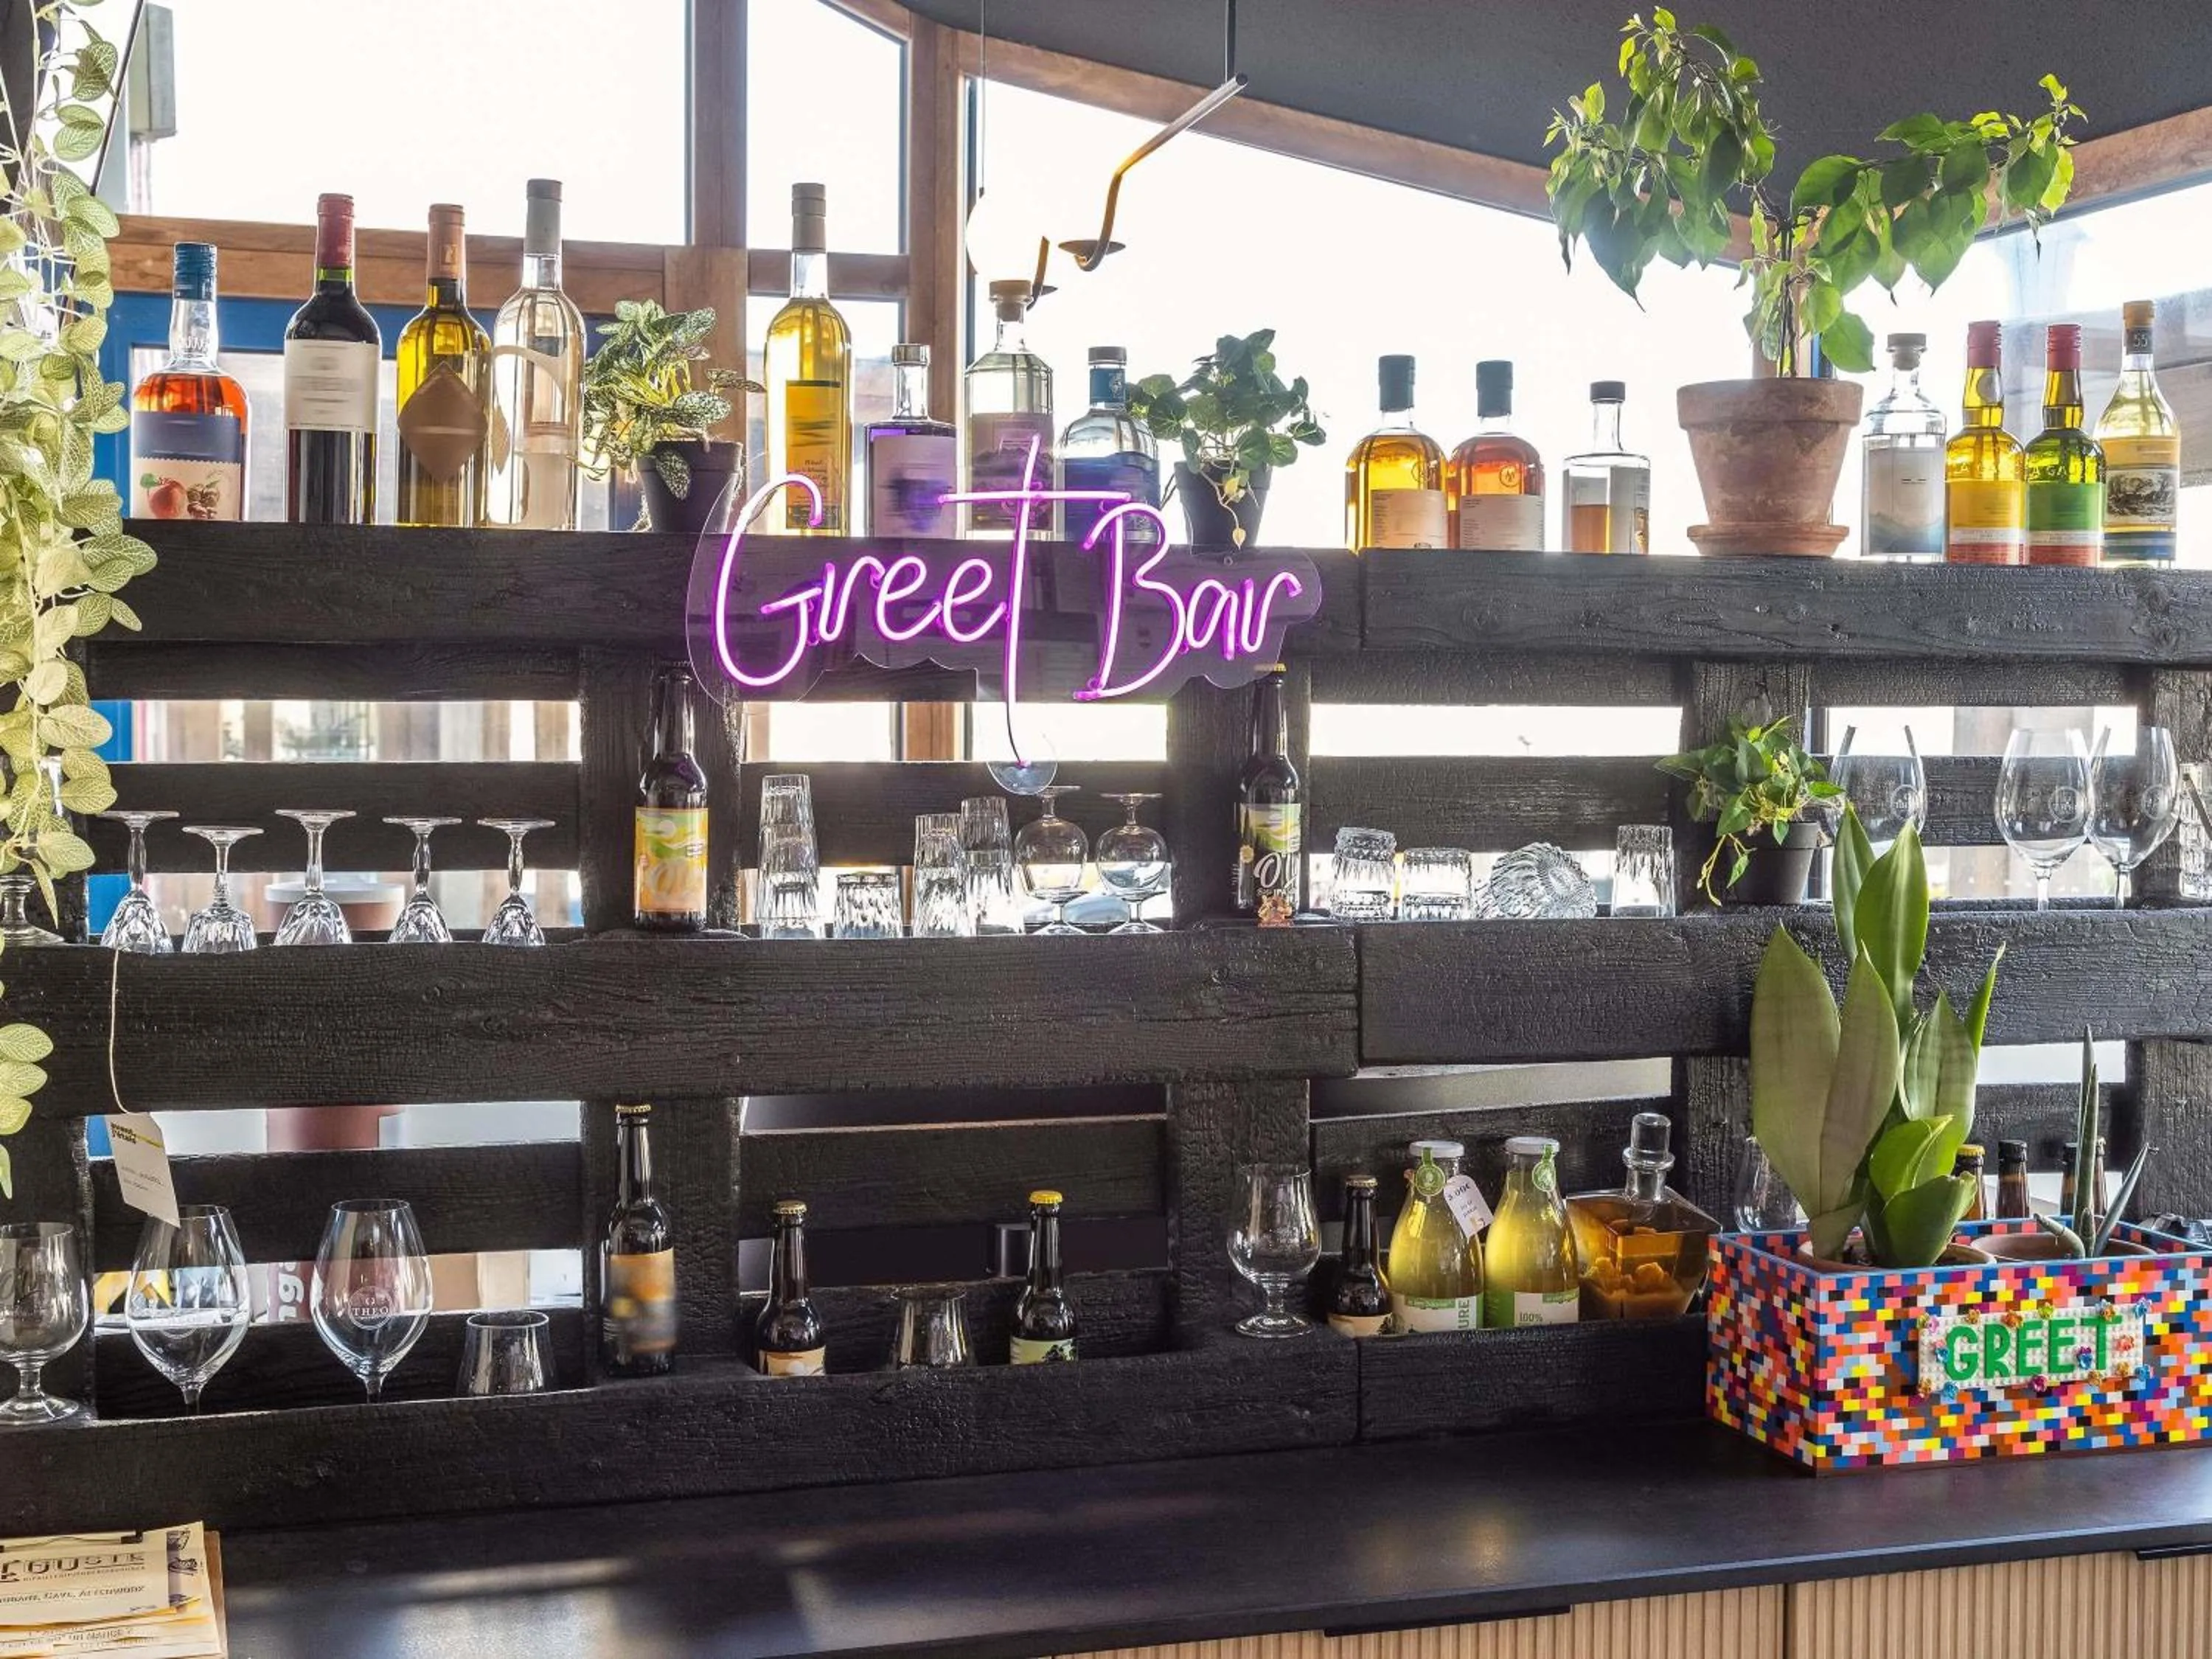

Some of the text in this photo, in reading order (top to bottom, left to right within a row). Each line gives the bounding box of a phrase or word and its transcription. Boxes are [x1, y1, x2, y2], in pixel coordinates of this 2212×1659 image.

[714, 434, 1303, 705] Greet Bar
[1458, 1299, 1470, 1329] URE
[1520, 1312, 1543, 1322] 100%
[1944, 1315, 2123, 1381] GREET
